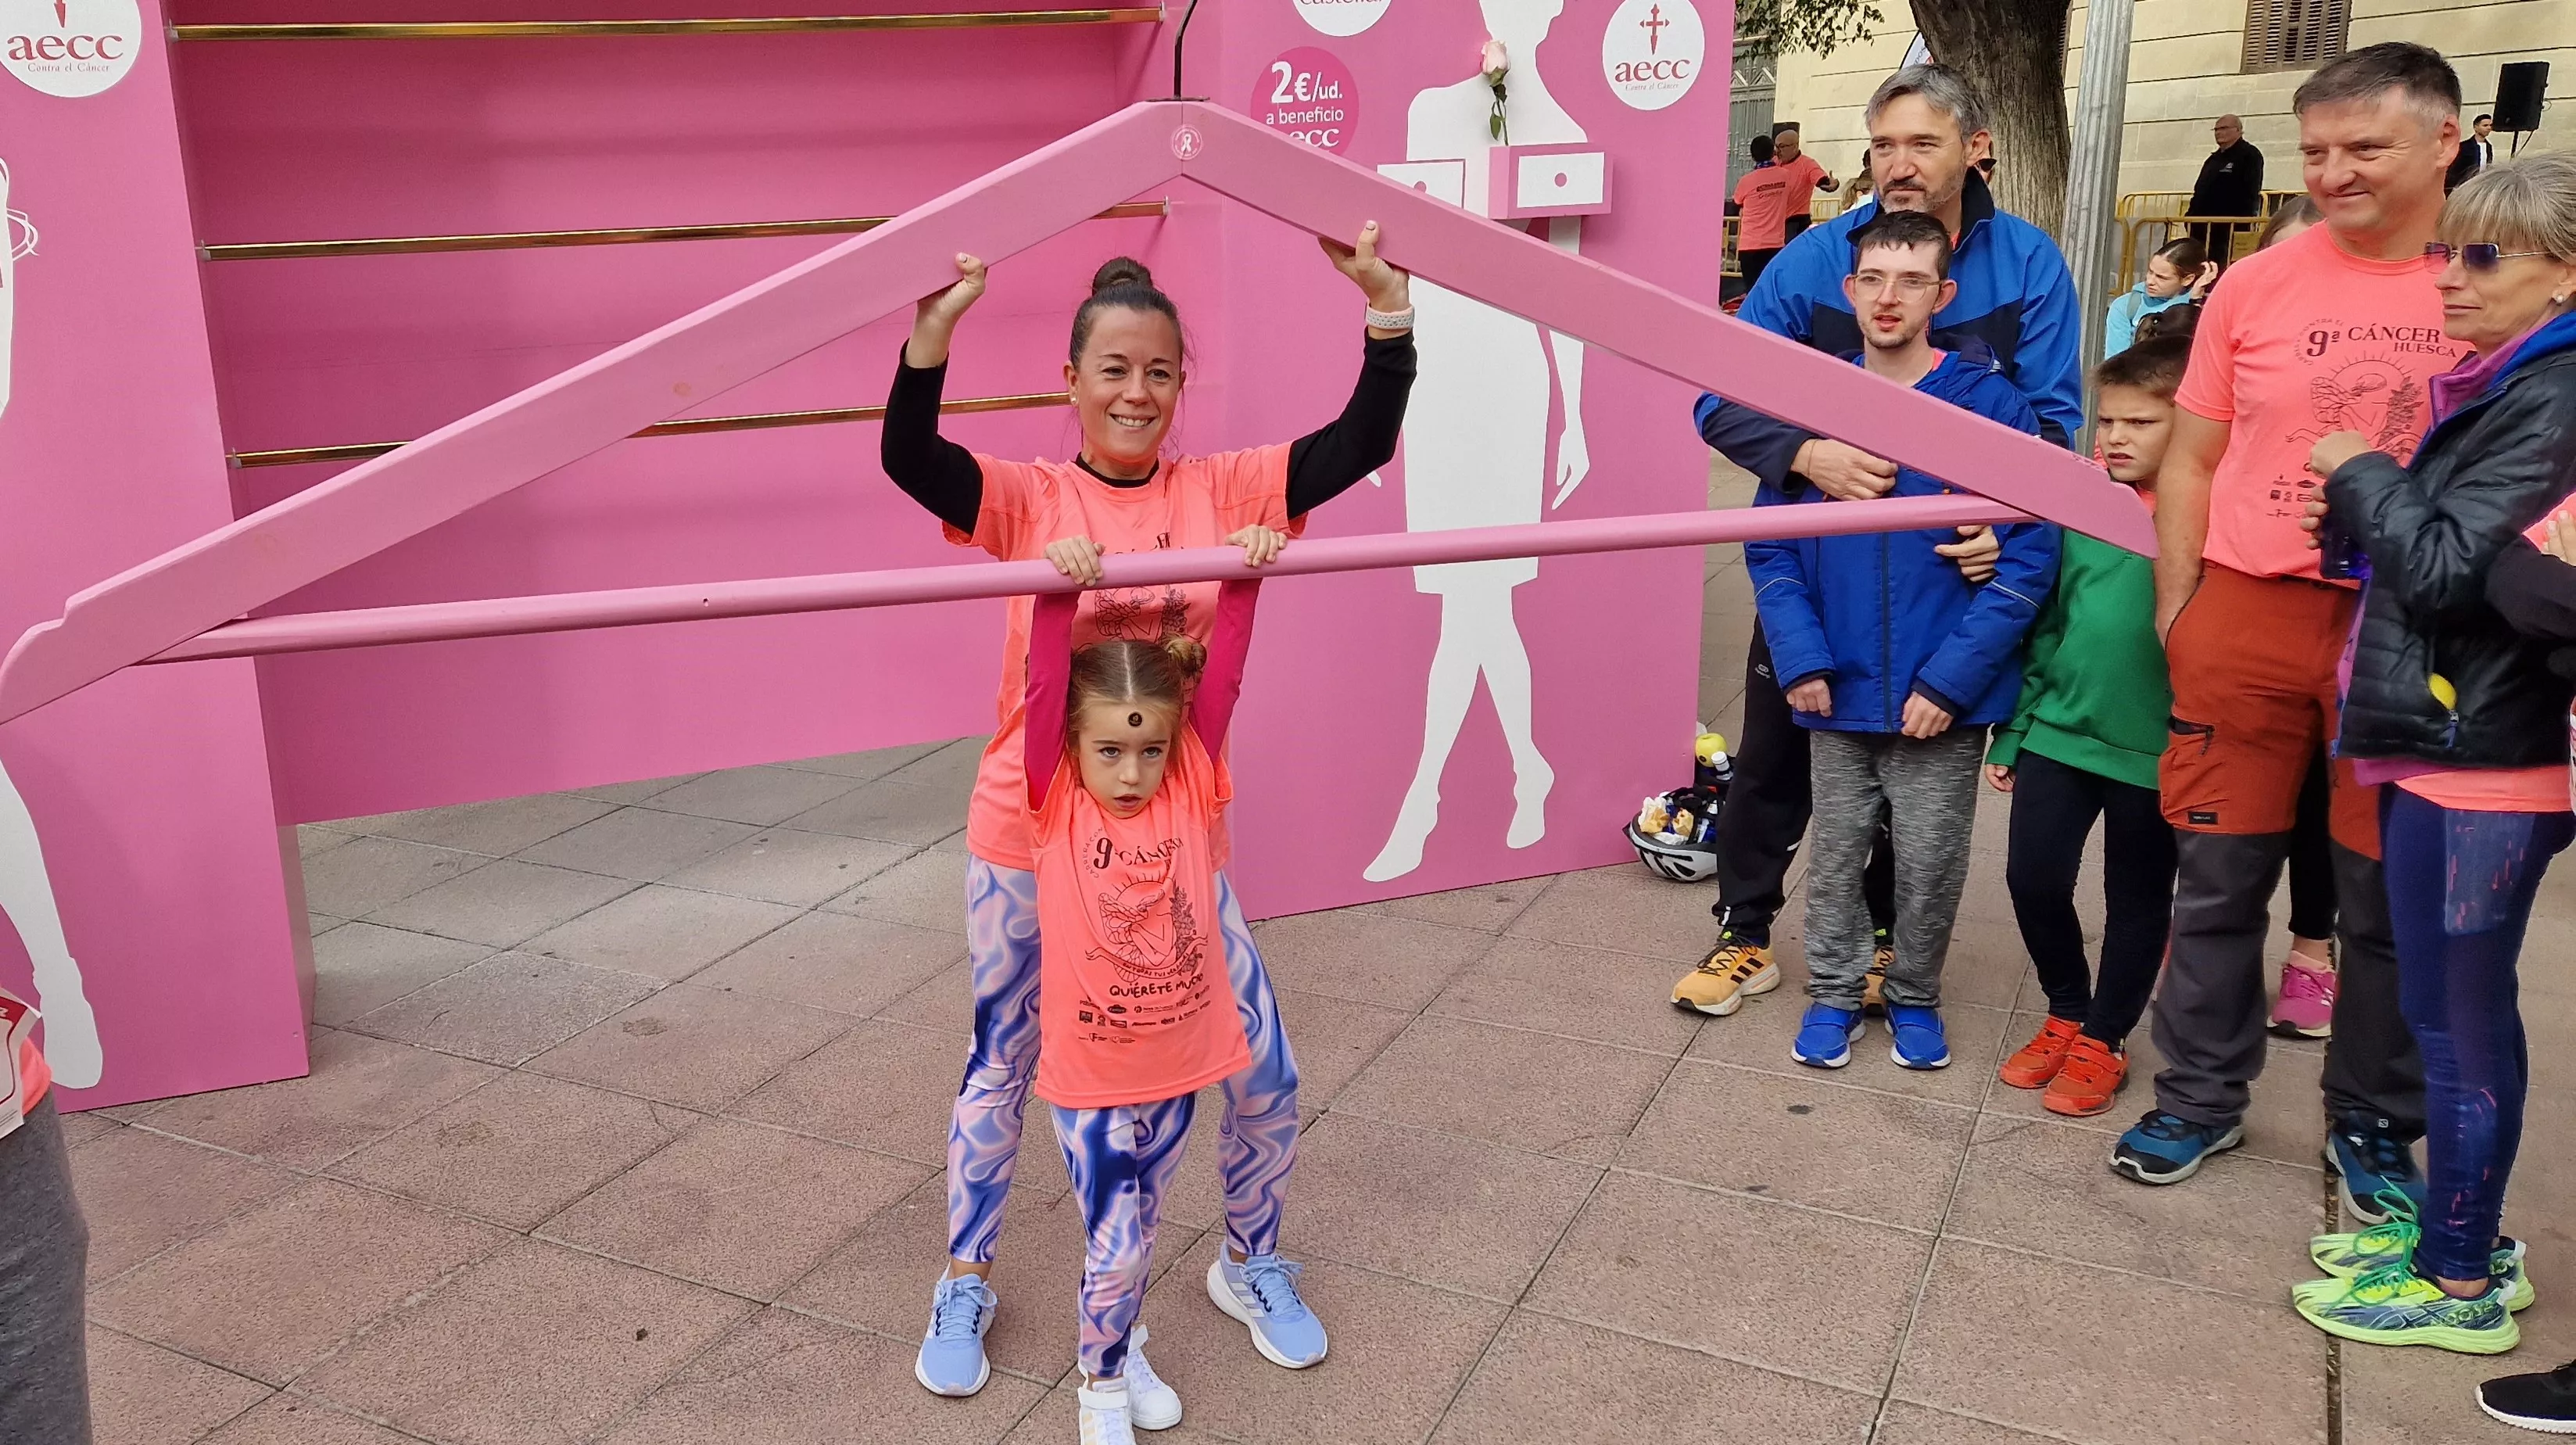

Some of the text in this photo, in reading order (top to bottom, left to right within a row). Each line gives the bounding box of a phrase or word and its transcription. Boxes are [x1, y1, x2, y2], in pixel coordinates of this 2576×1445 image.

[7, 35, 124, 60] aecc
[27, 63, 109, 72] Contra el Cáncer
[1614, 59, 1690, 82] aecc
[1267, 106, 1344, 124] a beneficio
[1288, 128, 1340, 148] ecc
[2348, 323, 2441, 343] CÁNCER
[2394, 342, 2458, 357] HUESCA
[1093, 837, 1113, 870] 9
[1109, 981, 1173, 999] QUIÉRETE
